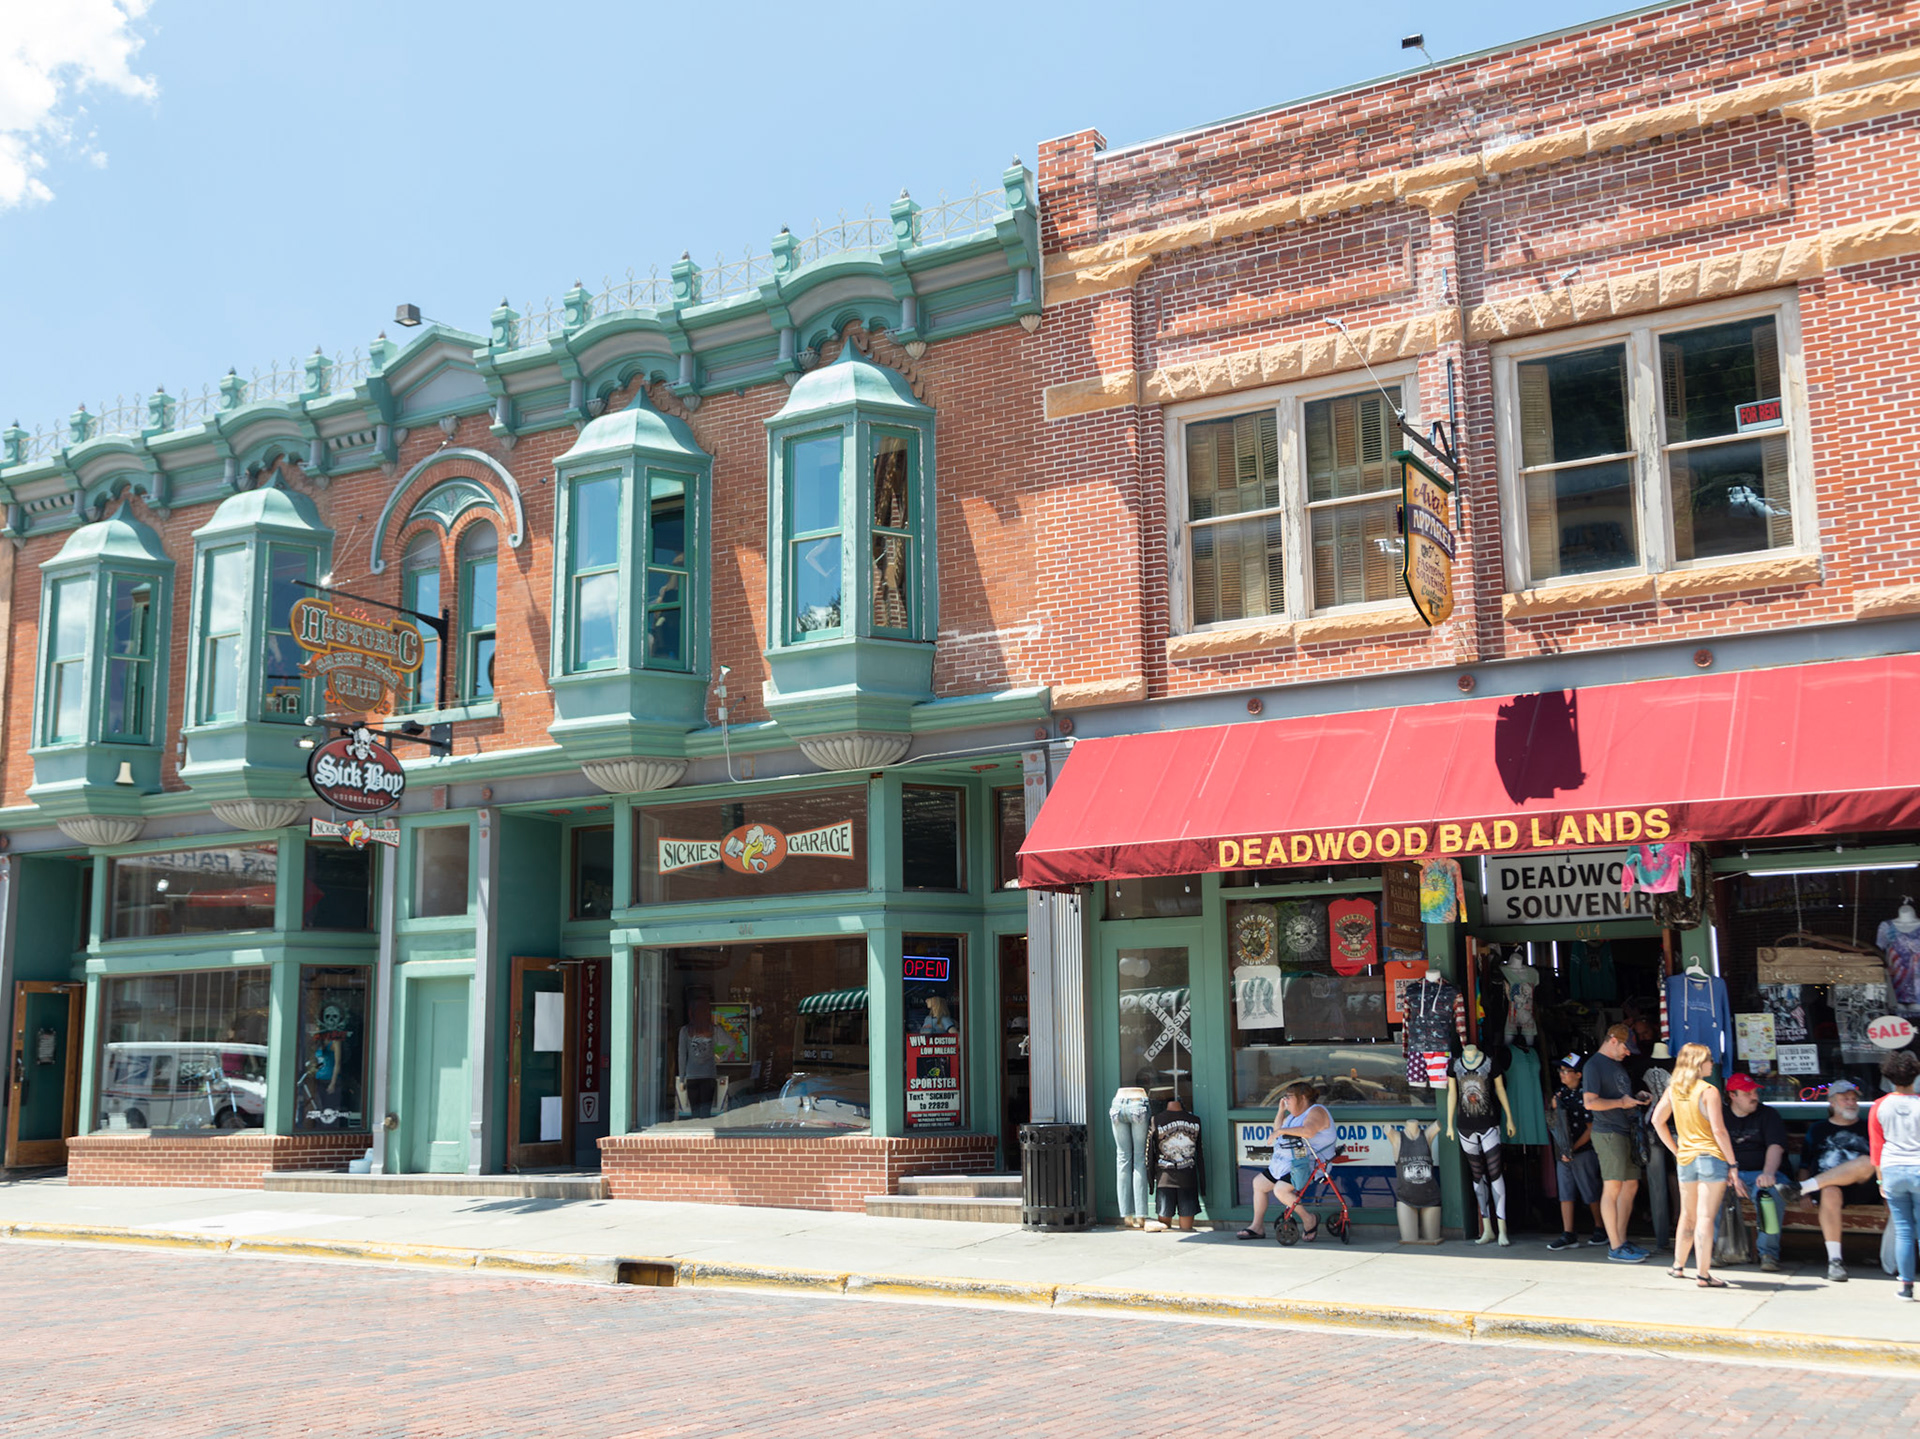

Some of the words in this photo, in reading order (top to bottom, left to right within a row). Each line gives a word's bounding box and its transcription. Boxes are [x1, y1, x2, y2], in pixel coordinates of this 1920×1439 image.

[1740, 406, 1758, 425] FOR
[1758, 401, 1780, 422] RENT
[1413, 509, 1454, 555] APPAREL
[1415, 567, 1448, 596] SOUVENIRS
[1417, 557, 1445, 583] FASHIONS
[301, 604, 418, 666] HISTORIC
[315, 651, 363, 674] GREEN
[364, 655, 400, 690] DOOR
[335, 672, 380, 701] CLUB
[314, 753, 362, 788] Sick
[363, 762, 403, 798] Boy
[333, 792, 385, 806] MOTORCYCLES
[664, 842, 719, 868] SICKIES
[789, 826, 850, 853] GARAGE
[1218, 826, 1428, 868] DEADWOOD
[1439, 820, 1518, 853] BAD
[1531, 808, 1671, 847] LANDS
[1388, 868, 1419, 887] DEADOOD
[1501, 861, 1624, 891] DEADWO
[1507, 892, 1652, 920] SOUVENIR
[1576, 924, 1600, 937] 614
[904, 959, 947, 977] OPEN
[585, 964, 597, 1088] Firestone
[1147, 1005, 1190, 1059] CROSSIN
[1867, 1021, 1911, 1039] SALE
[909, 1035, 926, 1047] WIN
[934, 1037, 956, 1045] CUSTOM
[920, 1047, 933, 1055] LOW
[934, 1047, 957, 1055] MILEAGE
[910, 1077, 957, 1089] SPORTSTER
[1799, 1086, 1829, 1100] OP
[909, 1093, 924, 1101] Text
[1243, 1126, 1275, 1141] MOD
